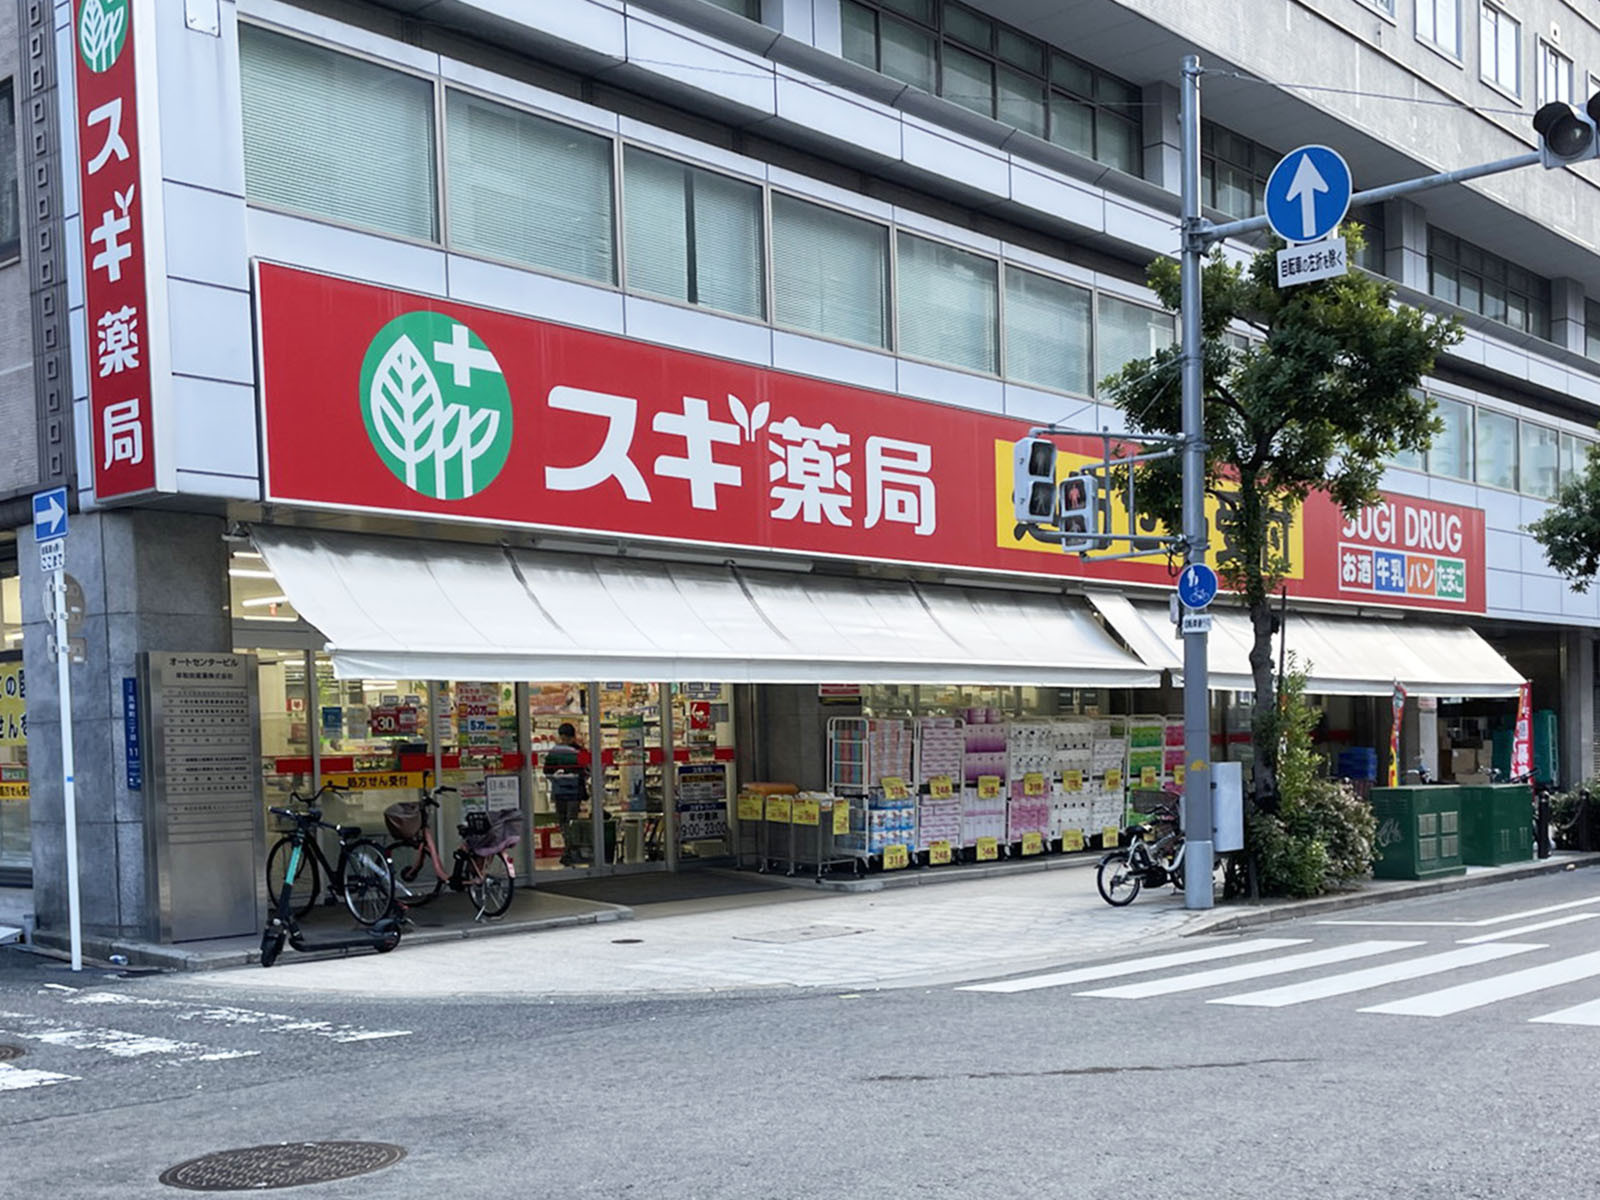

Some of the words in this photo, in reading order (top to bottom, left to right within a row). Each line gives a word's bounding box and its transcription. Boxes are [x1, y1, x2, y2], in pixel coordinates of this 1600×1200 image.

[87, 97, 144, 470] スギ薬局
[1281, 249, 1344, 278] 自転車の左折を除く
[545, 385, 937, 536] スギ薬局
[1404, 506, 1463, 553] DRUG
[1342, 554, 1372, 585] お酒
[1376, 557, 1405, 588] 牛乳
[1408, 562, 1434, 589] パン
[1436, 564, 1464, 594] たまご
[169, 657, 239, 668] オートセンタービル
[347, 775, 408, 788] 処方せん受付
